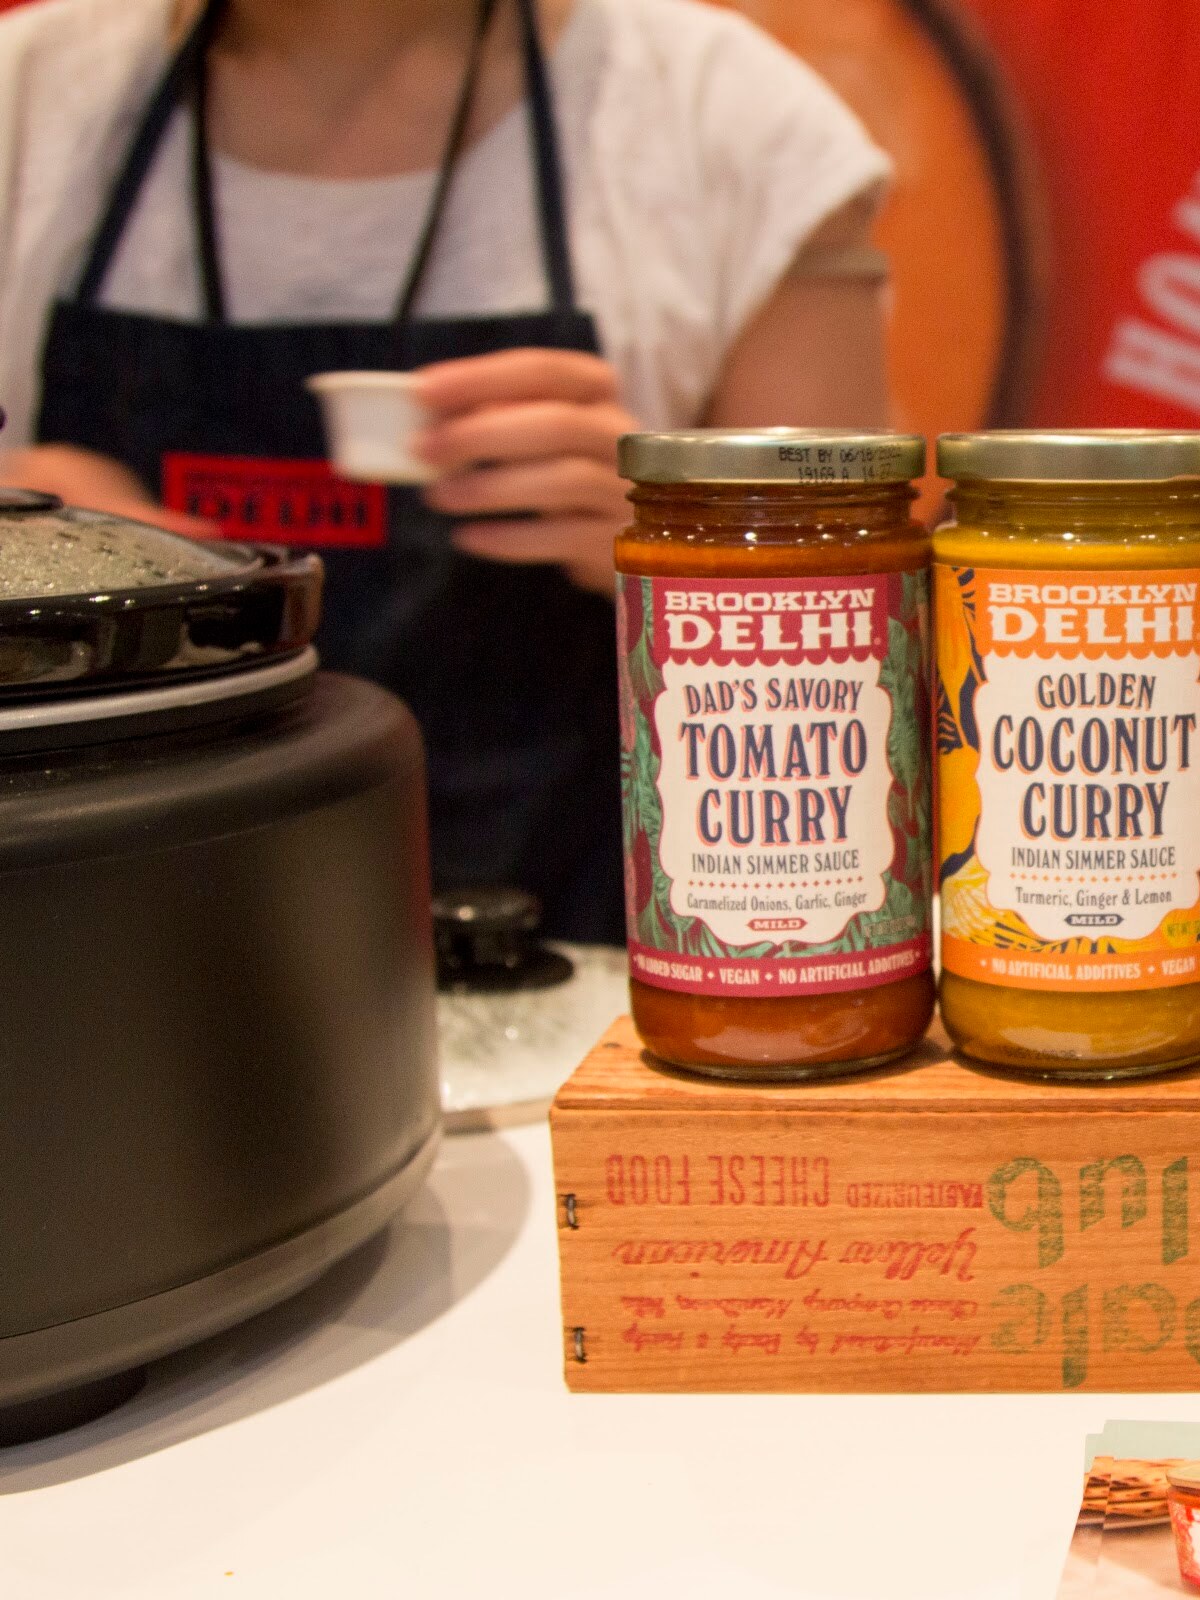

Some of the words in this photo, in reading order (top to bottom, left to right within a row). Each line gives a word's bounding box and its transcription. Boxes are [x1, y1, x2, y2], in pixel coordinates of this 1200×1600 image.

[779, 447, 809, 462] BEST
[818, 449, 832, 463] BY
[664, 587, 875, 612] BROOKLYN
[988, 582, 1197, 605] BROOKLYN
[664, 611, 873, 650] DELHI
[988, 605, 1195, 644] DELHI
[683, 678, 757, 715] DAD'S
[765, 678, 864, 712] SAVORY
[1036, 672, 1157, 712] GOLDEN
[679, 719, 868, 782] TOMATO
[992, 713, 1196, 776] COCONUT
[696, 785, 853, 847] CURRY
[1020, 781, 1170, 841] CURRY
[692, 852, 742, 875] INDIAN
[747, 851, 809, 874] SIMMER
[814, 849, 860, 873] SAUCE
[1011, 847, 1060, 869] INDIAN
[1065, 848, 1126, 871] SIMMER
[1131, 846, 1176, 868] SAUCE
[687, 892, 746, 912] Caramelized
[751, 896, 791, 912] Onions,
[795, 893, 831, 911] Garlic,
[835, 891, 868, 908] Ginger
[1016, 886, 1073, 907] Turmeric,
[1076, 889, 1117, 910] Ginger
[1122, 889, 1131, 906] &
[1135, 886, 1172, 905] Lemon
[753, 918, 801, 931] MILD
[1071, 914, 1118, 926] MILD
[671, 962, 703, 982] SUGAR
[719, 967, 760, 985] VEGAN
[779, 967, 797, 984] NO
[799, 961, 866, 983] ARTIFICIAL
[868, 950, 917, 976] ADDITIVES
[992, 958, 1006, 974] NO
[1008, 961, 1073, 979] ARTIFICIAL
[1076, 962, 1141, 980] ADDITIVES
[1161, 956, 1196, 976] VEGAN
[605, 1153, 690, 1207] FOOD
[708, 1154, 831, 1208] CHEESE
[845, 1182, 984, 1208] PASTEURIZED
[610, 1238, 829, 1280] American
[838, 1226, 980, 1282] Yellow
